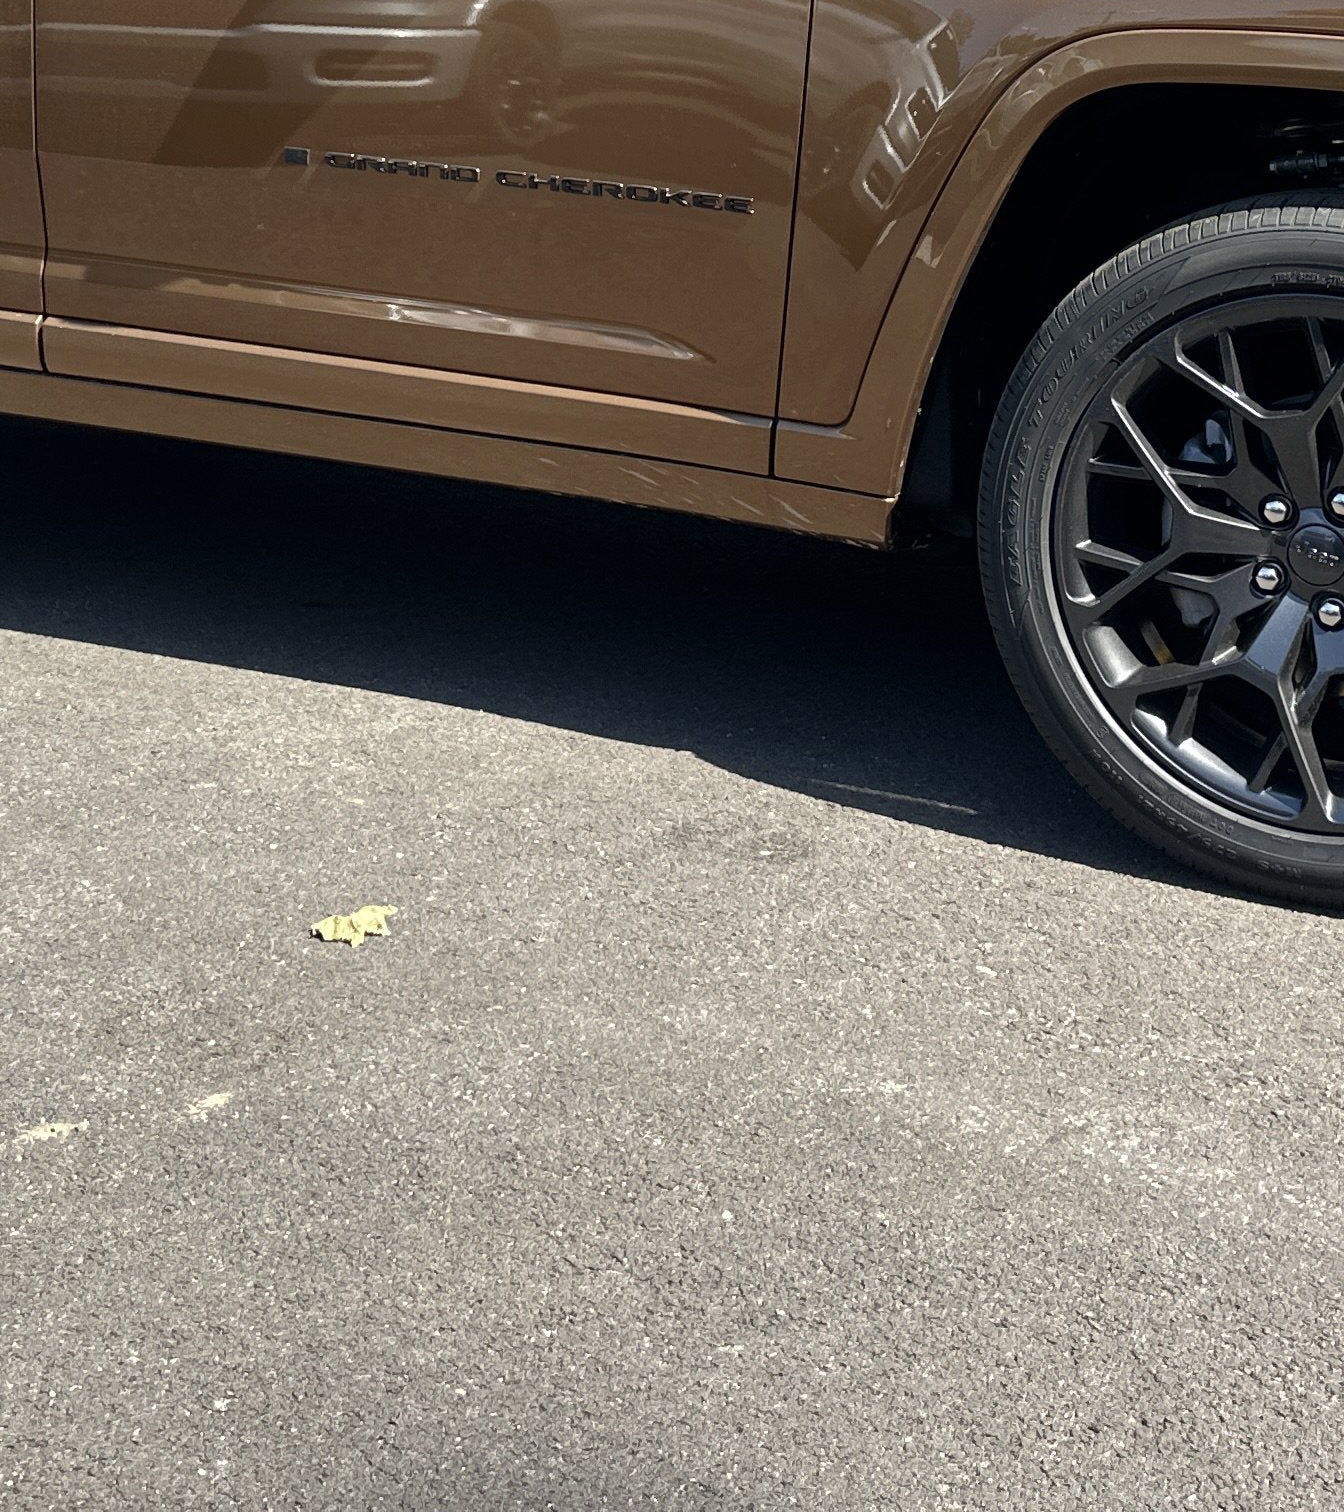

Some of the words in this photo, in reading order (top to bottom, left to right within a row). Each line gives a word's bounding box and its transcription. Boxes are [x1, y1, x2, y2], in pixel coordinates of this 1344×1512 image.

[324, 151, 481, 183] GRAND
[495, 170, 755, 215] CHEROKEE
[1027, 286, 1149, 430] TOURING
